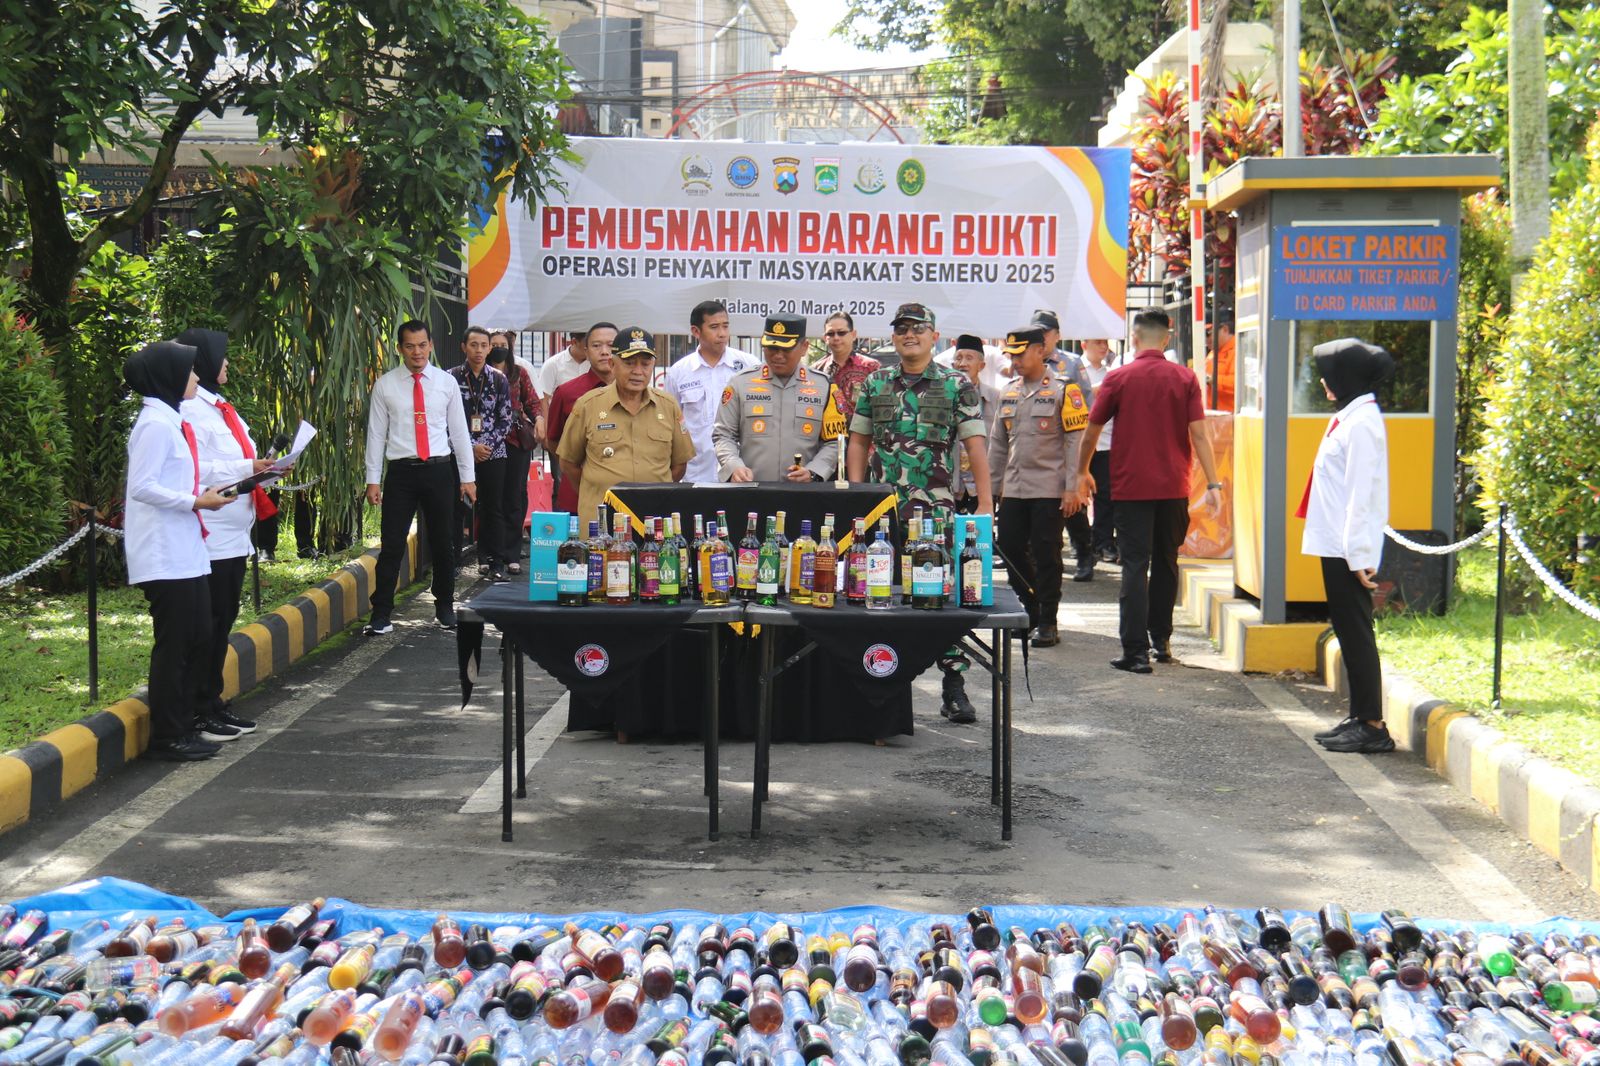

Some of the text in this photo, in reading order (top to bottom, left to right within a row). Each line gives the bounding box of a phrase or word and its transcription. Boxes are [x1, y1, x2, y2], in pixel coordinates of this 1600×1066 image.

[102, 179, 140, 187] WOOL
[541, 206, 1057, 257] PEMUSNAHAN BARANG BUKTI
[1282, 235, 1448, 260] LOKET PARKIR
[542, 256, 1055, 284] OPERASI PENYAKIT MASYARAKAT SEMERU 2025
[1284, 268, 1352, 285] TUNJUKKAN
[1358, 268, 1393, 285] TIKET
[778, 300, 796, 313] 20
[801, 301, 844, 316] Maret
[850, 302, 885, 316] 2025
[1313, 295, 1345, 311] CARD
[1351, 295, 1397, 311] PARKIR
[1402, 296, 1437, 311] ANDA
[798, 396, 822, 404] POLRI
